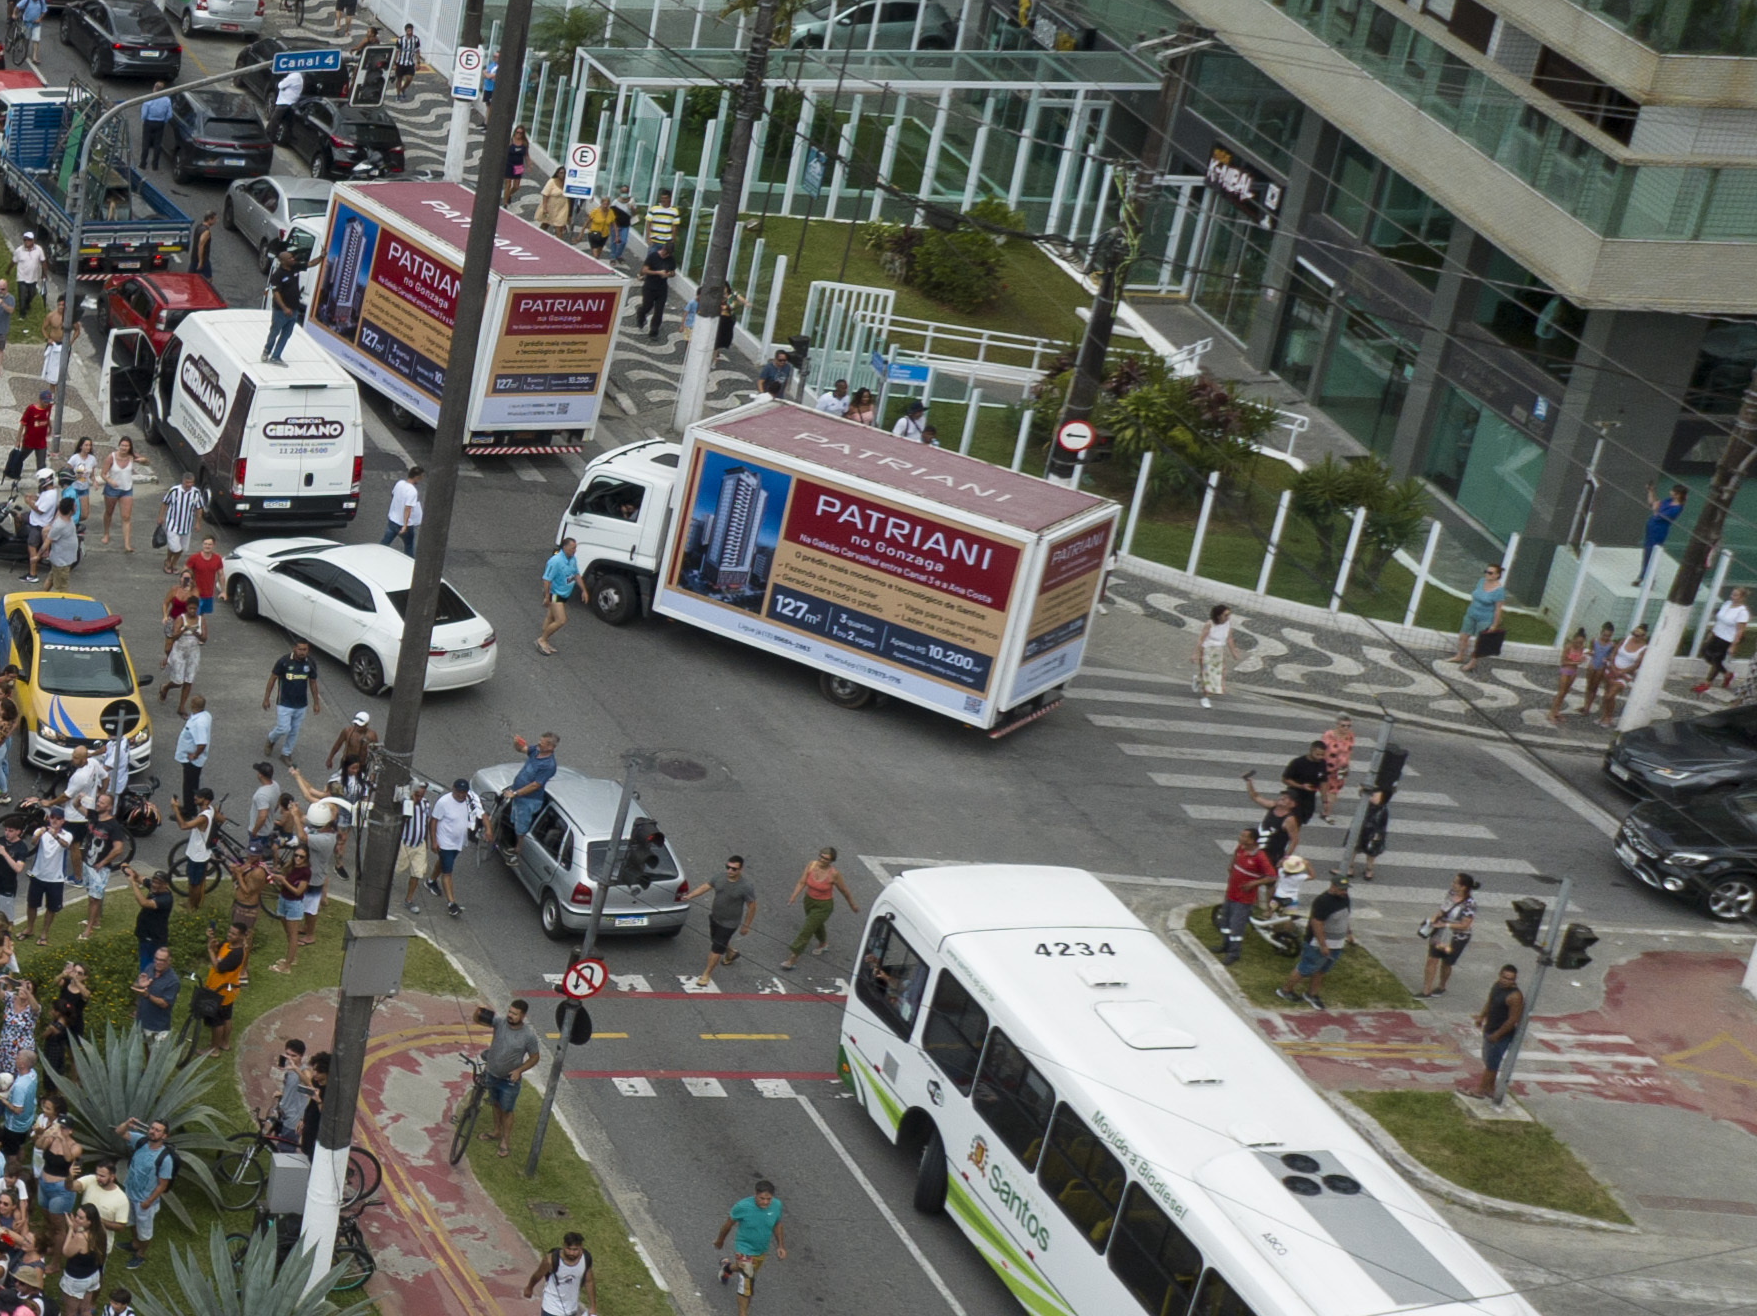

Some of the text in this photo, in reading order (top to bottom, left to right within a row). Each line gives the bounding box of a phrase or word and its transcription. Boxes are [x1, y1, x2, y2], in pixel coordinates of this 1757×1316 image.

[279, 54, 335, 69] Canal 4
[464, 53, 474, 66] E
[579, 150, 589, 163] E
[388, 241, 461, 299] PATRIAN
[519, 299, 606, 313] PATRIANI
[183, 359, 225, 421] GERMANO
[265, 424, 342, 438] GERMANO
[793, 432, 1013, 503] PATRIANI
[815, 494, 993, 571] PATRIANI
[799, 533, 811, 545] Na
[840, 546, 880, 566] Carvalhal
[879, 561, 903, 574] entre
[902, 567, 928, 583] Canal
[965, 589, 993, 604] Costa
[850, 535, 945, 573] no Gonzaga
[849, 569, 886, 587] moderno
[956, 604, 986, 621] Santos
[839, 613, 848, 624] 3
[847, 630, 856, 641] 2
[1035, 942, 1116, 957] 4234
[1091, 1110, 1129, 1157] Movido
[1137, 1161, 1189, 1222] Biodiesel
[987, 1164, 1050, 1253] Santos
